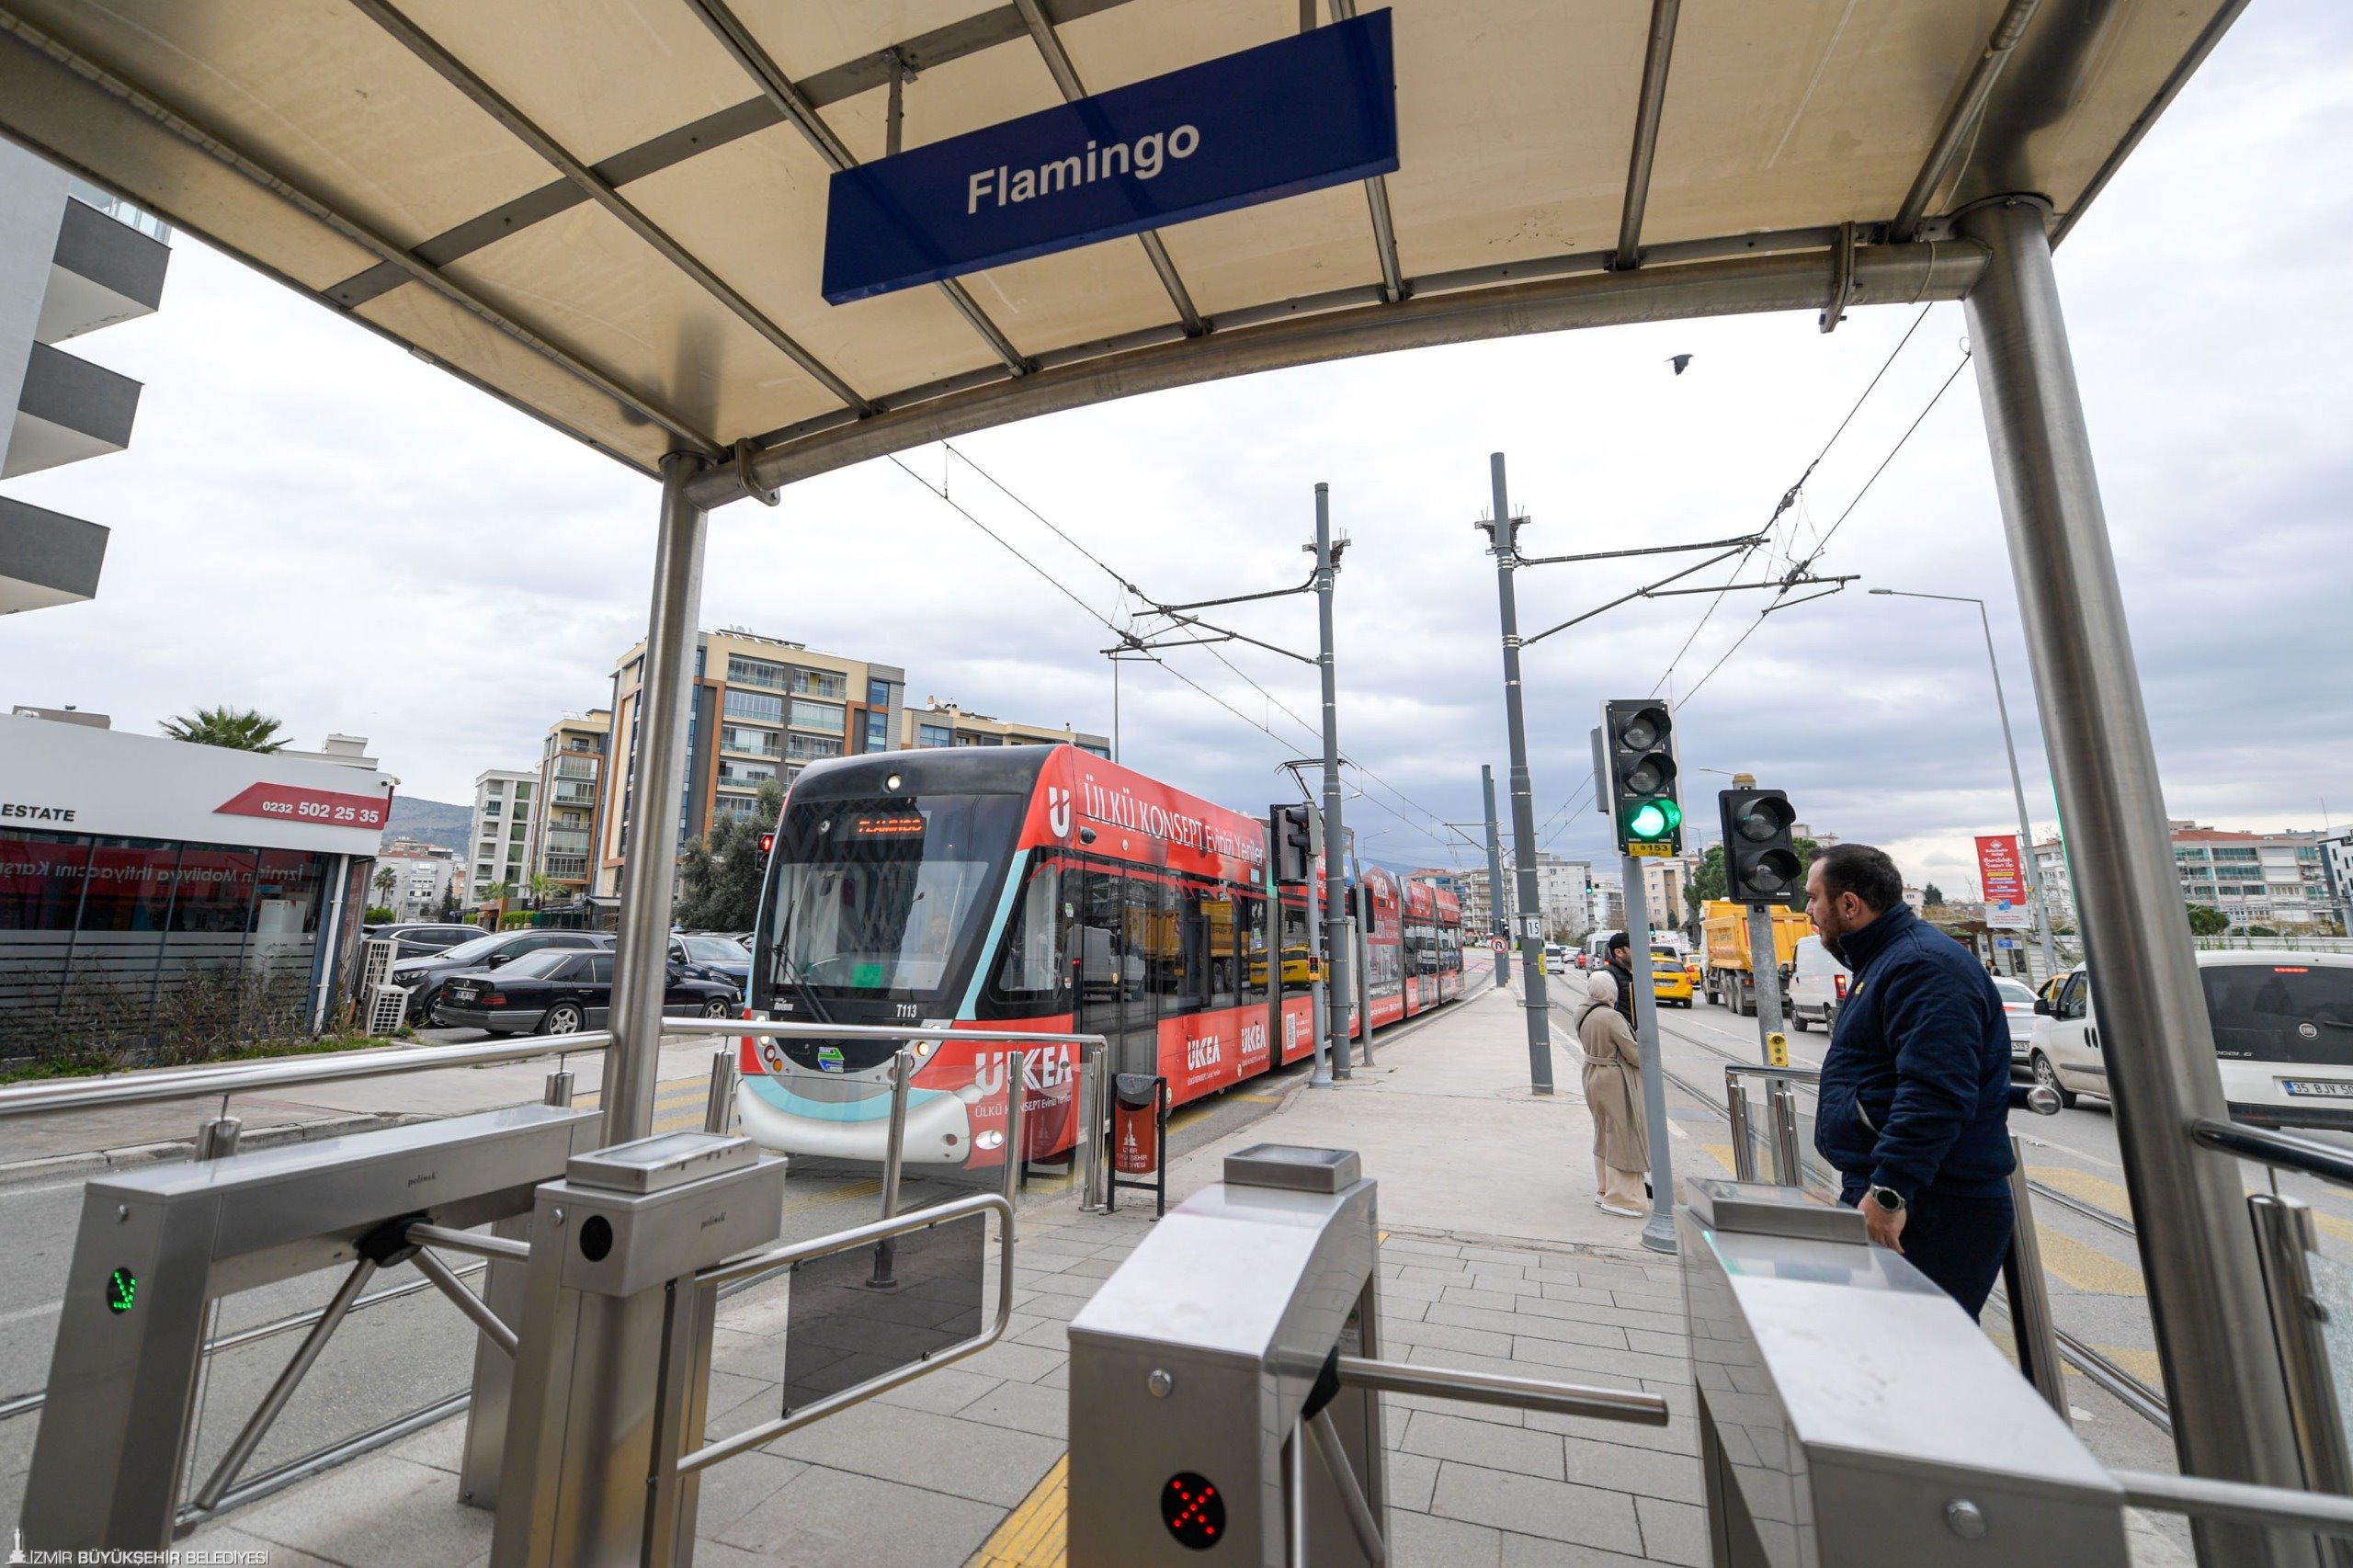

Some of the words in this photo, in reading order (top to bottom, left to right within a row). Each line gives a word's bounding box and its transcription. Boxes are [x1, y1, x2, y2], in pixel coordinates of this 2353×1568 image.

[966, 123, 1201, 216] Flamingo
[1, 803, 76, 822] ESTATE
[262, 801, 294, 813] 0232
[298, 801, 331, 818] 502
[334, 806, 356, 820] 25
[359, 809, 380, 824] 35
[1083, 773, 1136, 832] ÜLKÜ
[1139, 801, 1203, 851] KONSEPT
[1205, 825, 1234, 857] Evinizi
[1647, 844, 1668, 852] 153
[1528, 922, 1540, 935] 15
[896, 1004, 917, 1018] T113
[2295, 1083, 2310, 1093] 35
[2314, 1084, 2336, 1094] BJV
[975, 1103, 1003, 1118] ÜLKÜ
